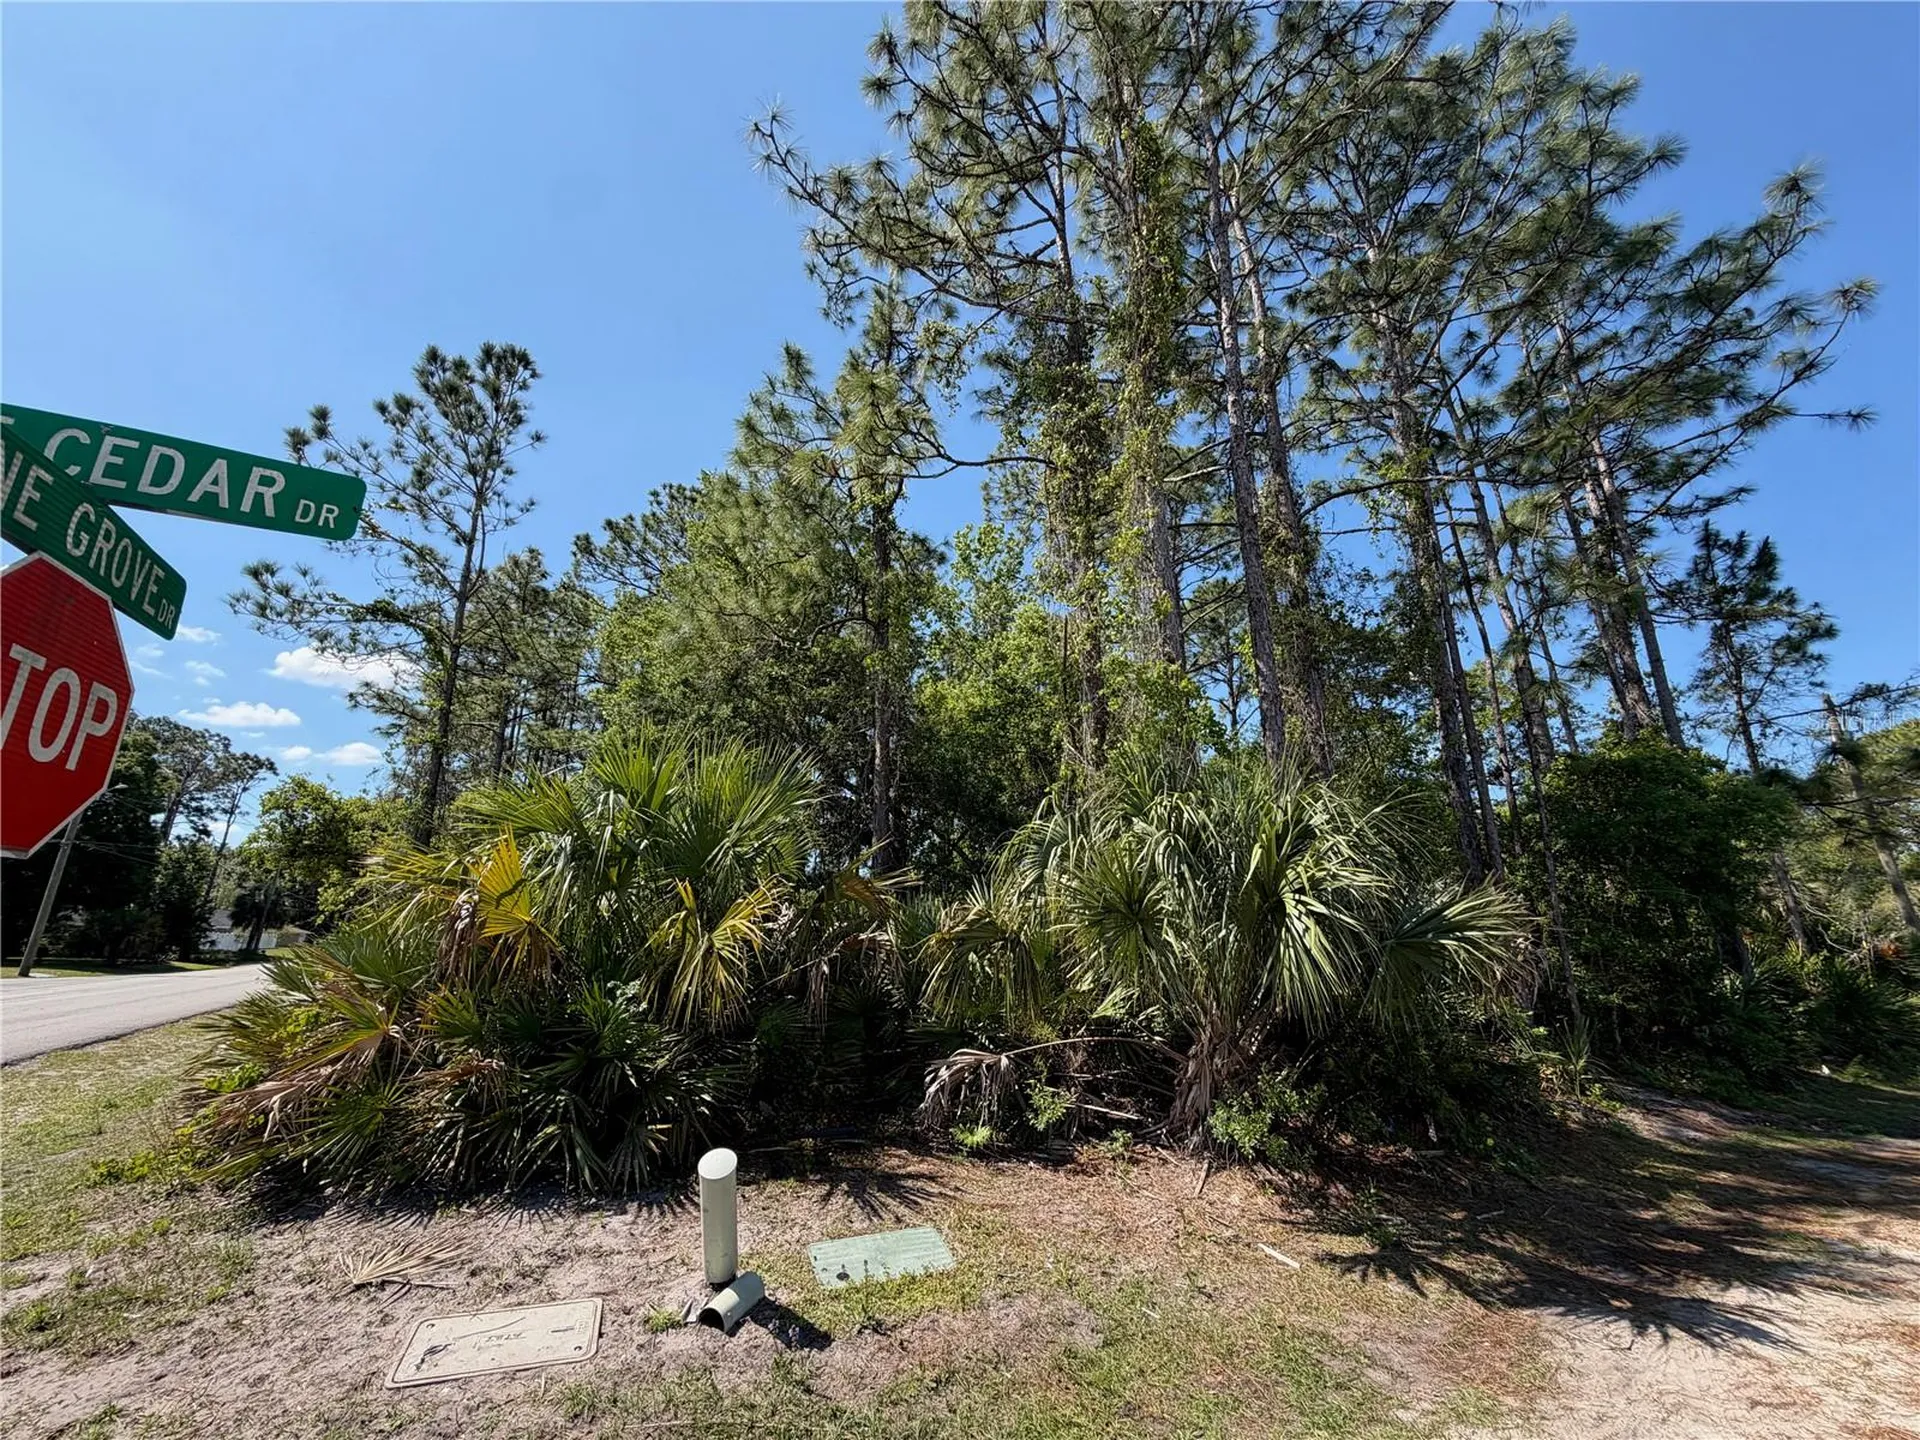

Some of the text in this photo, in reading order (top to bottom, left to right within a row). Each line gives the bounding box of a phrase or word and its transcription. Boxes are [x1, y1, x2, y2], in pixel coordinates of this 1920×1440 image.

[43, 427, 340, 529] CEDAR DR
[65, 502, 165, 617] GROVE
[157, 598, 175, 630] DR
